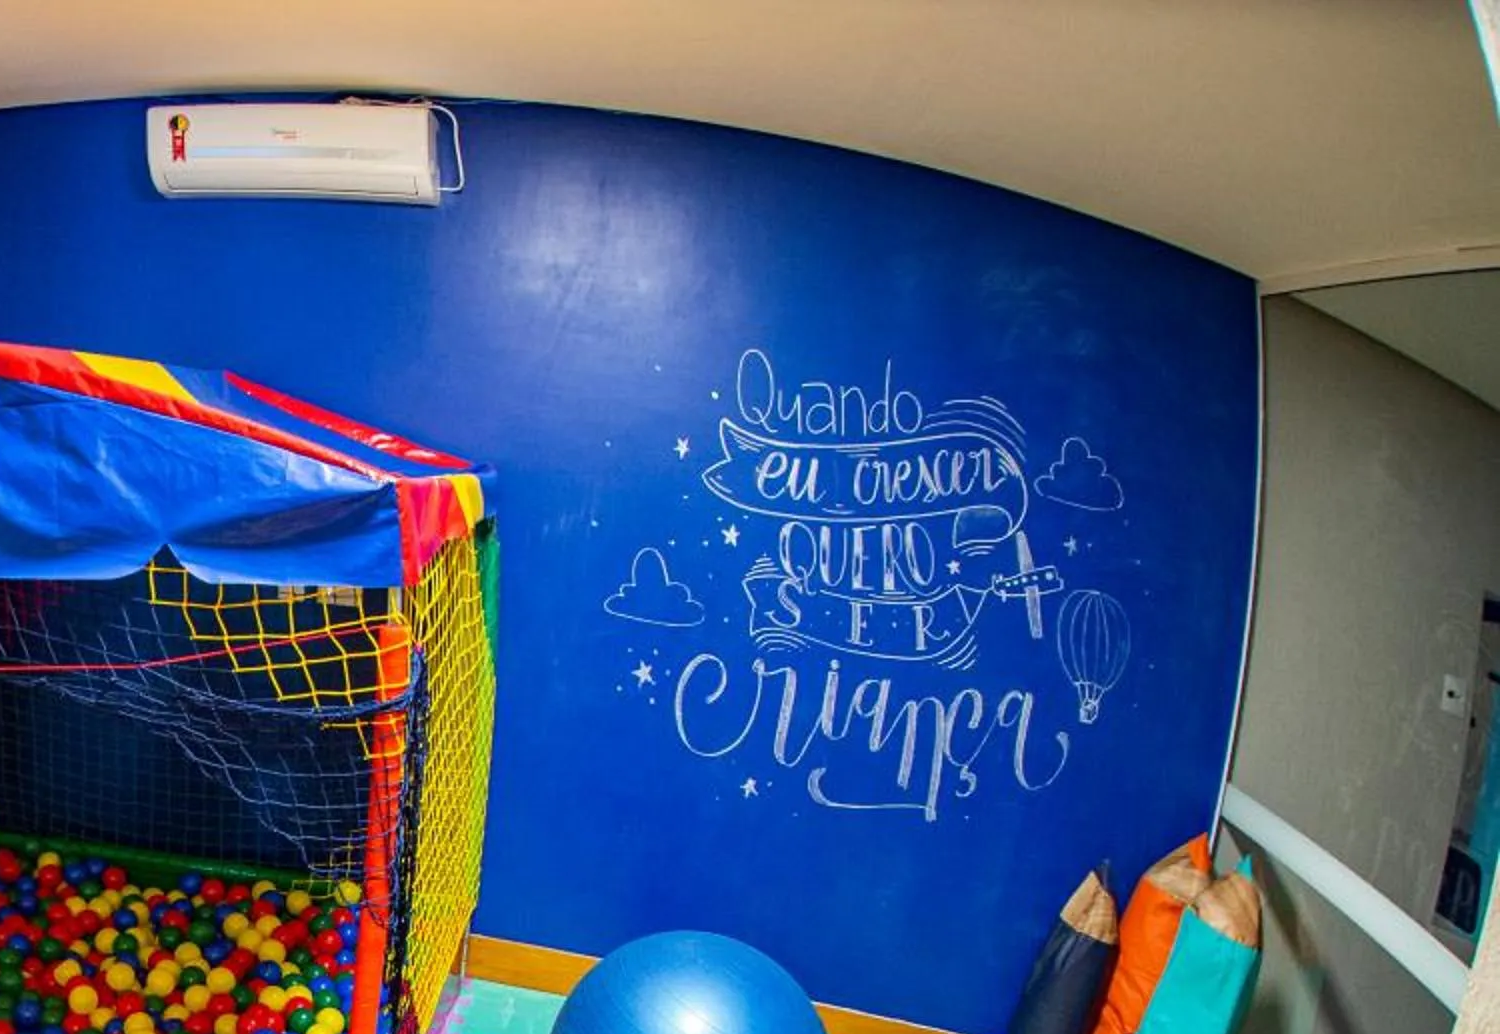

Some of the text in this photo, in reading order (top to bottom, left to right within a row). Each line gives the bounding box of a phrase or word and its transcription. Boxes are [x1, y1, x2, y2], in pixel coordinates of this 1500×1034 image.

[736, 348, 923, 436] Quando
[756, 447, 1007, 503] eu crescer
[778, 521, 937, 596] QUERO
